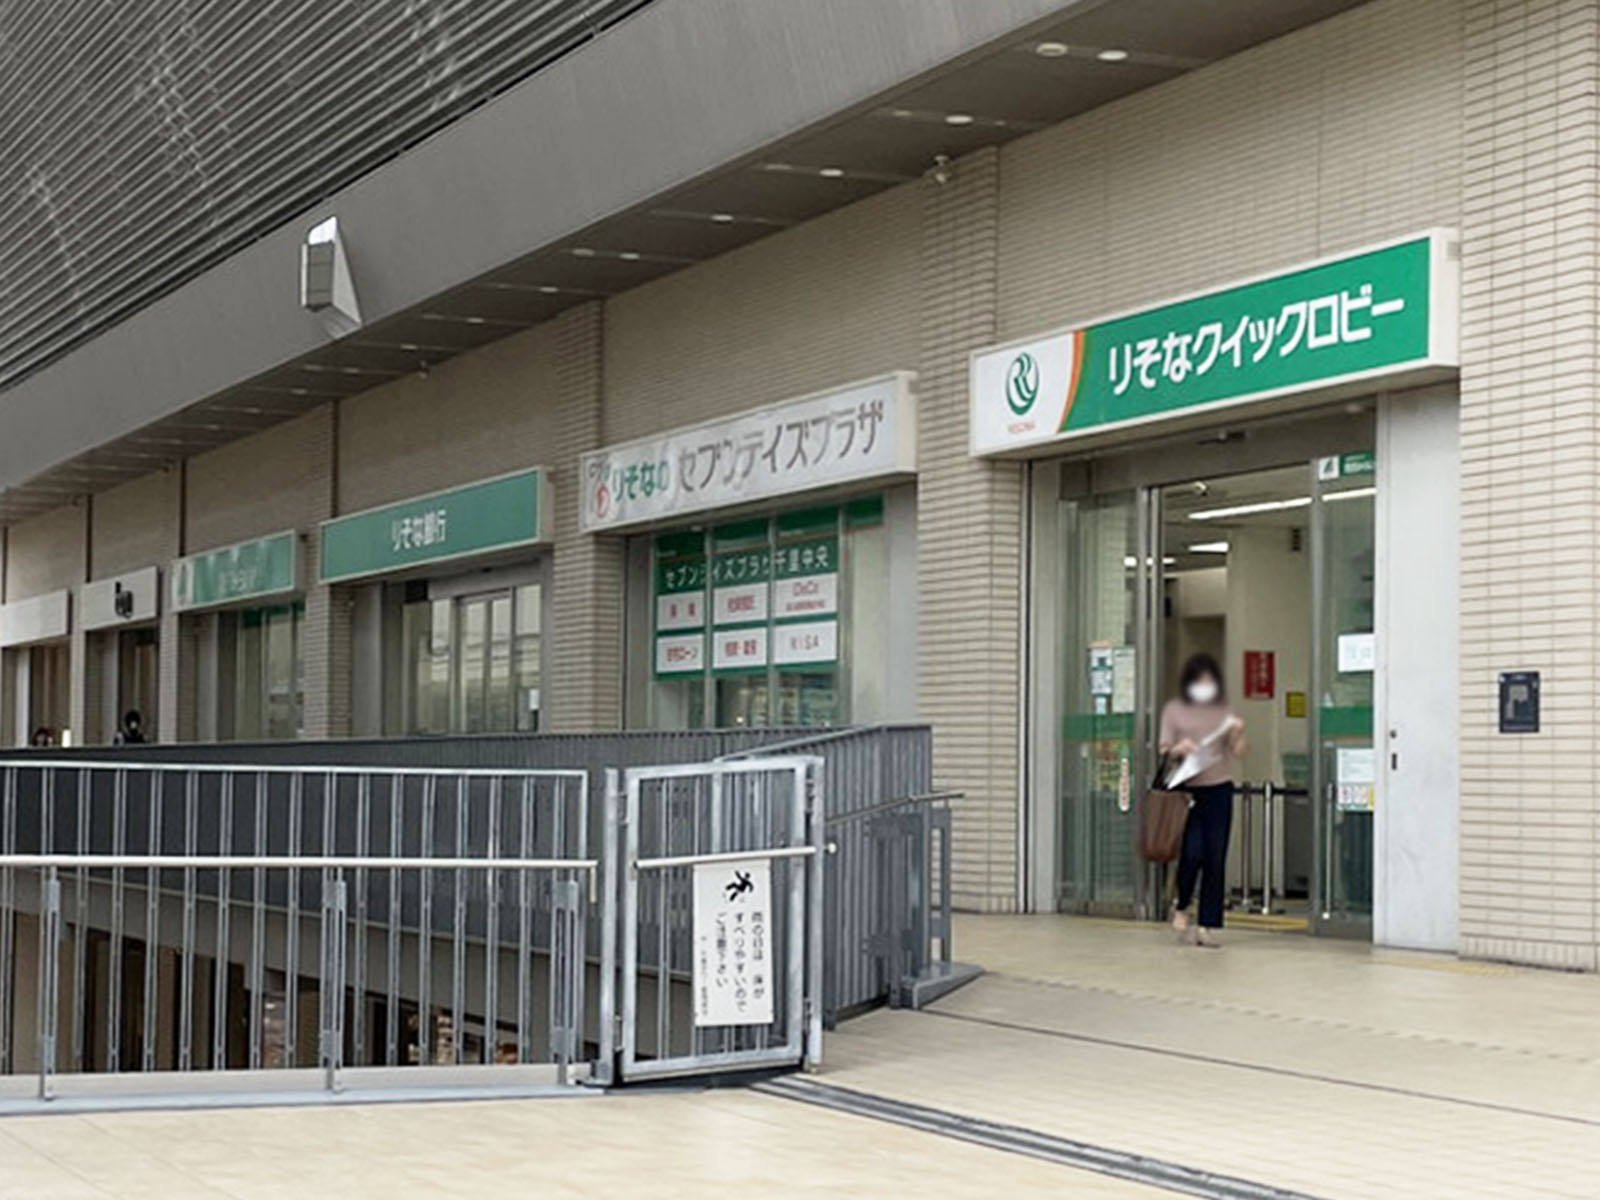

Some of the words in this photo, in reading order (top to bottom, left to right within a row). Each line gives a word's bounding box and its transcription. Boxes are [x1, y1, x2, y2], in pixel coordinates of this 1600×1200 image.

[1108, 284, 1405, 396] りそなクイックロビー
